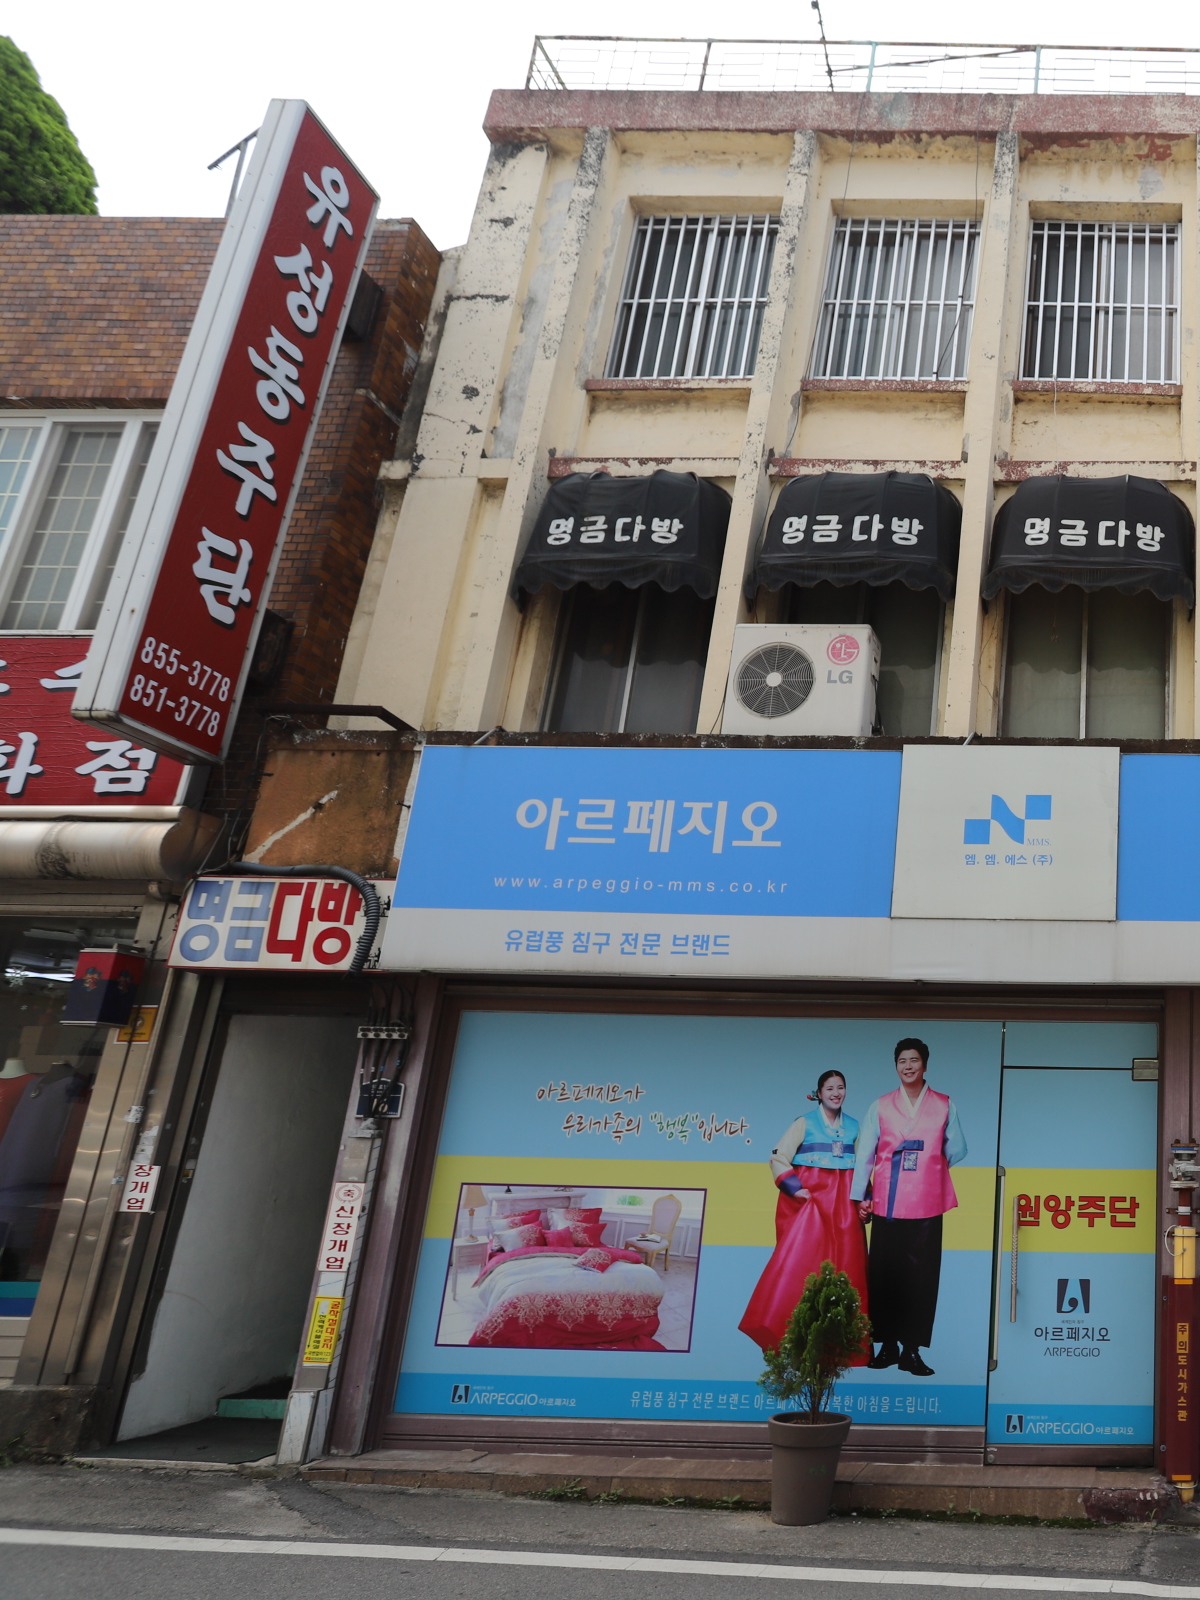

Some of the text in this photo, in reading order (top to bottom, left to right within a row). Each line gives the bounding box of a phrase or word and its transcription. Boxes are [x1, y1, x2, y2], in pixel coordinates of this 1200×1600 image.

[192, 165, 353, 627] 유성동주단
[546, 514, 684, 547] 명금다방
[781, 514, 924, 546] 명금다방
[1023, 516, 1165, 552] 명금다방
[140, 636, 231, 702] 855-3778
[826, 669, 854, 685] LG
[129, 674, 221, 738] 851-3778
[516, 798, 781, 854] 아르페지오
[964, 854, 1053, 866] 엠. 엠. 에스 (주)
[493, 875, 789, 895] www.arpeggio-mms.co.kr
[179, 880, 362, 965] 명금다방
[504, 930, 731, 958] 유럽풍 침구 전문 브랜드
[537, 1082, 645, 1103] 아르페지오가
[562, 1113, 642, 1143] 우리가족의
[127, 1165, 154, 1210] 장개업
[1016, 1193, 1140, 1230] 원앙주단
[325, 1206, 355, 1270] 신장개업
[1034, 1326, 1111, 1342] 아르페지오
[1043, 1347, 1101, 1358] ARPEGGIO
[1177, 1324, 1188, 1422] 주의 도시가스관
[470, 1392, 577, 1407] ARPEGGIO 아르페지오
[629, 1391, 663, 1408] 유럽풍
[667, 1391, 689, 1409] 침구
[692, 1392, 714, 1410] 전문
[717, 1392, 750, 1411] 브랜드
[856, 1395, 890, 1413] 아침을
[893, 1395, 942, 1414] 드립니다.
[1025, 1422, 1135, 1435] ARPEGGIO 아르페지오
